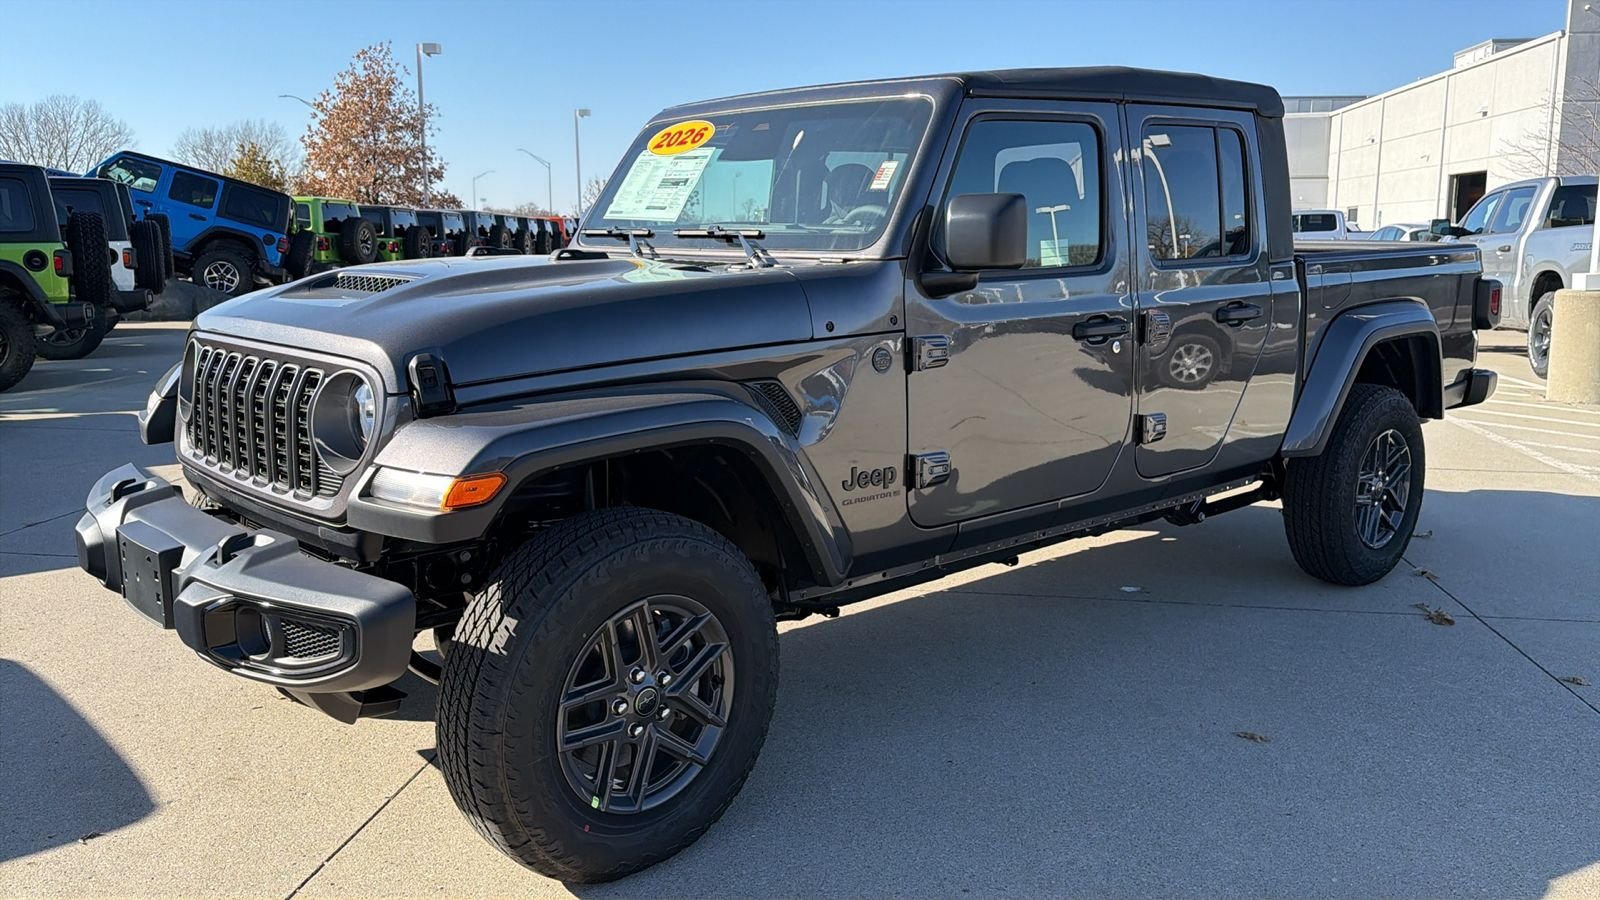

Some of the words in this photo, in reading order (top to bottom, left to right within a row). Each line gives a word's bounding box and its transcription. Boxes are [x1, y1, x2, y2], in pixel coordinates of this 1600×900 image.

[652, 127, 709, 150] 2026
[841, 466, 897, 491] Jeep
[841, 491, 892, 506] GLADIATOR
